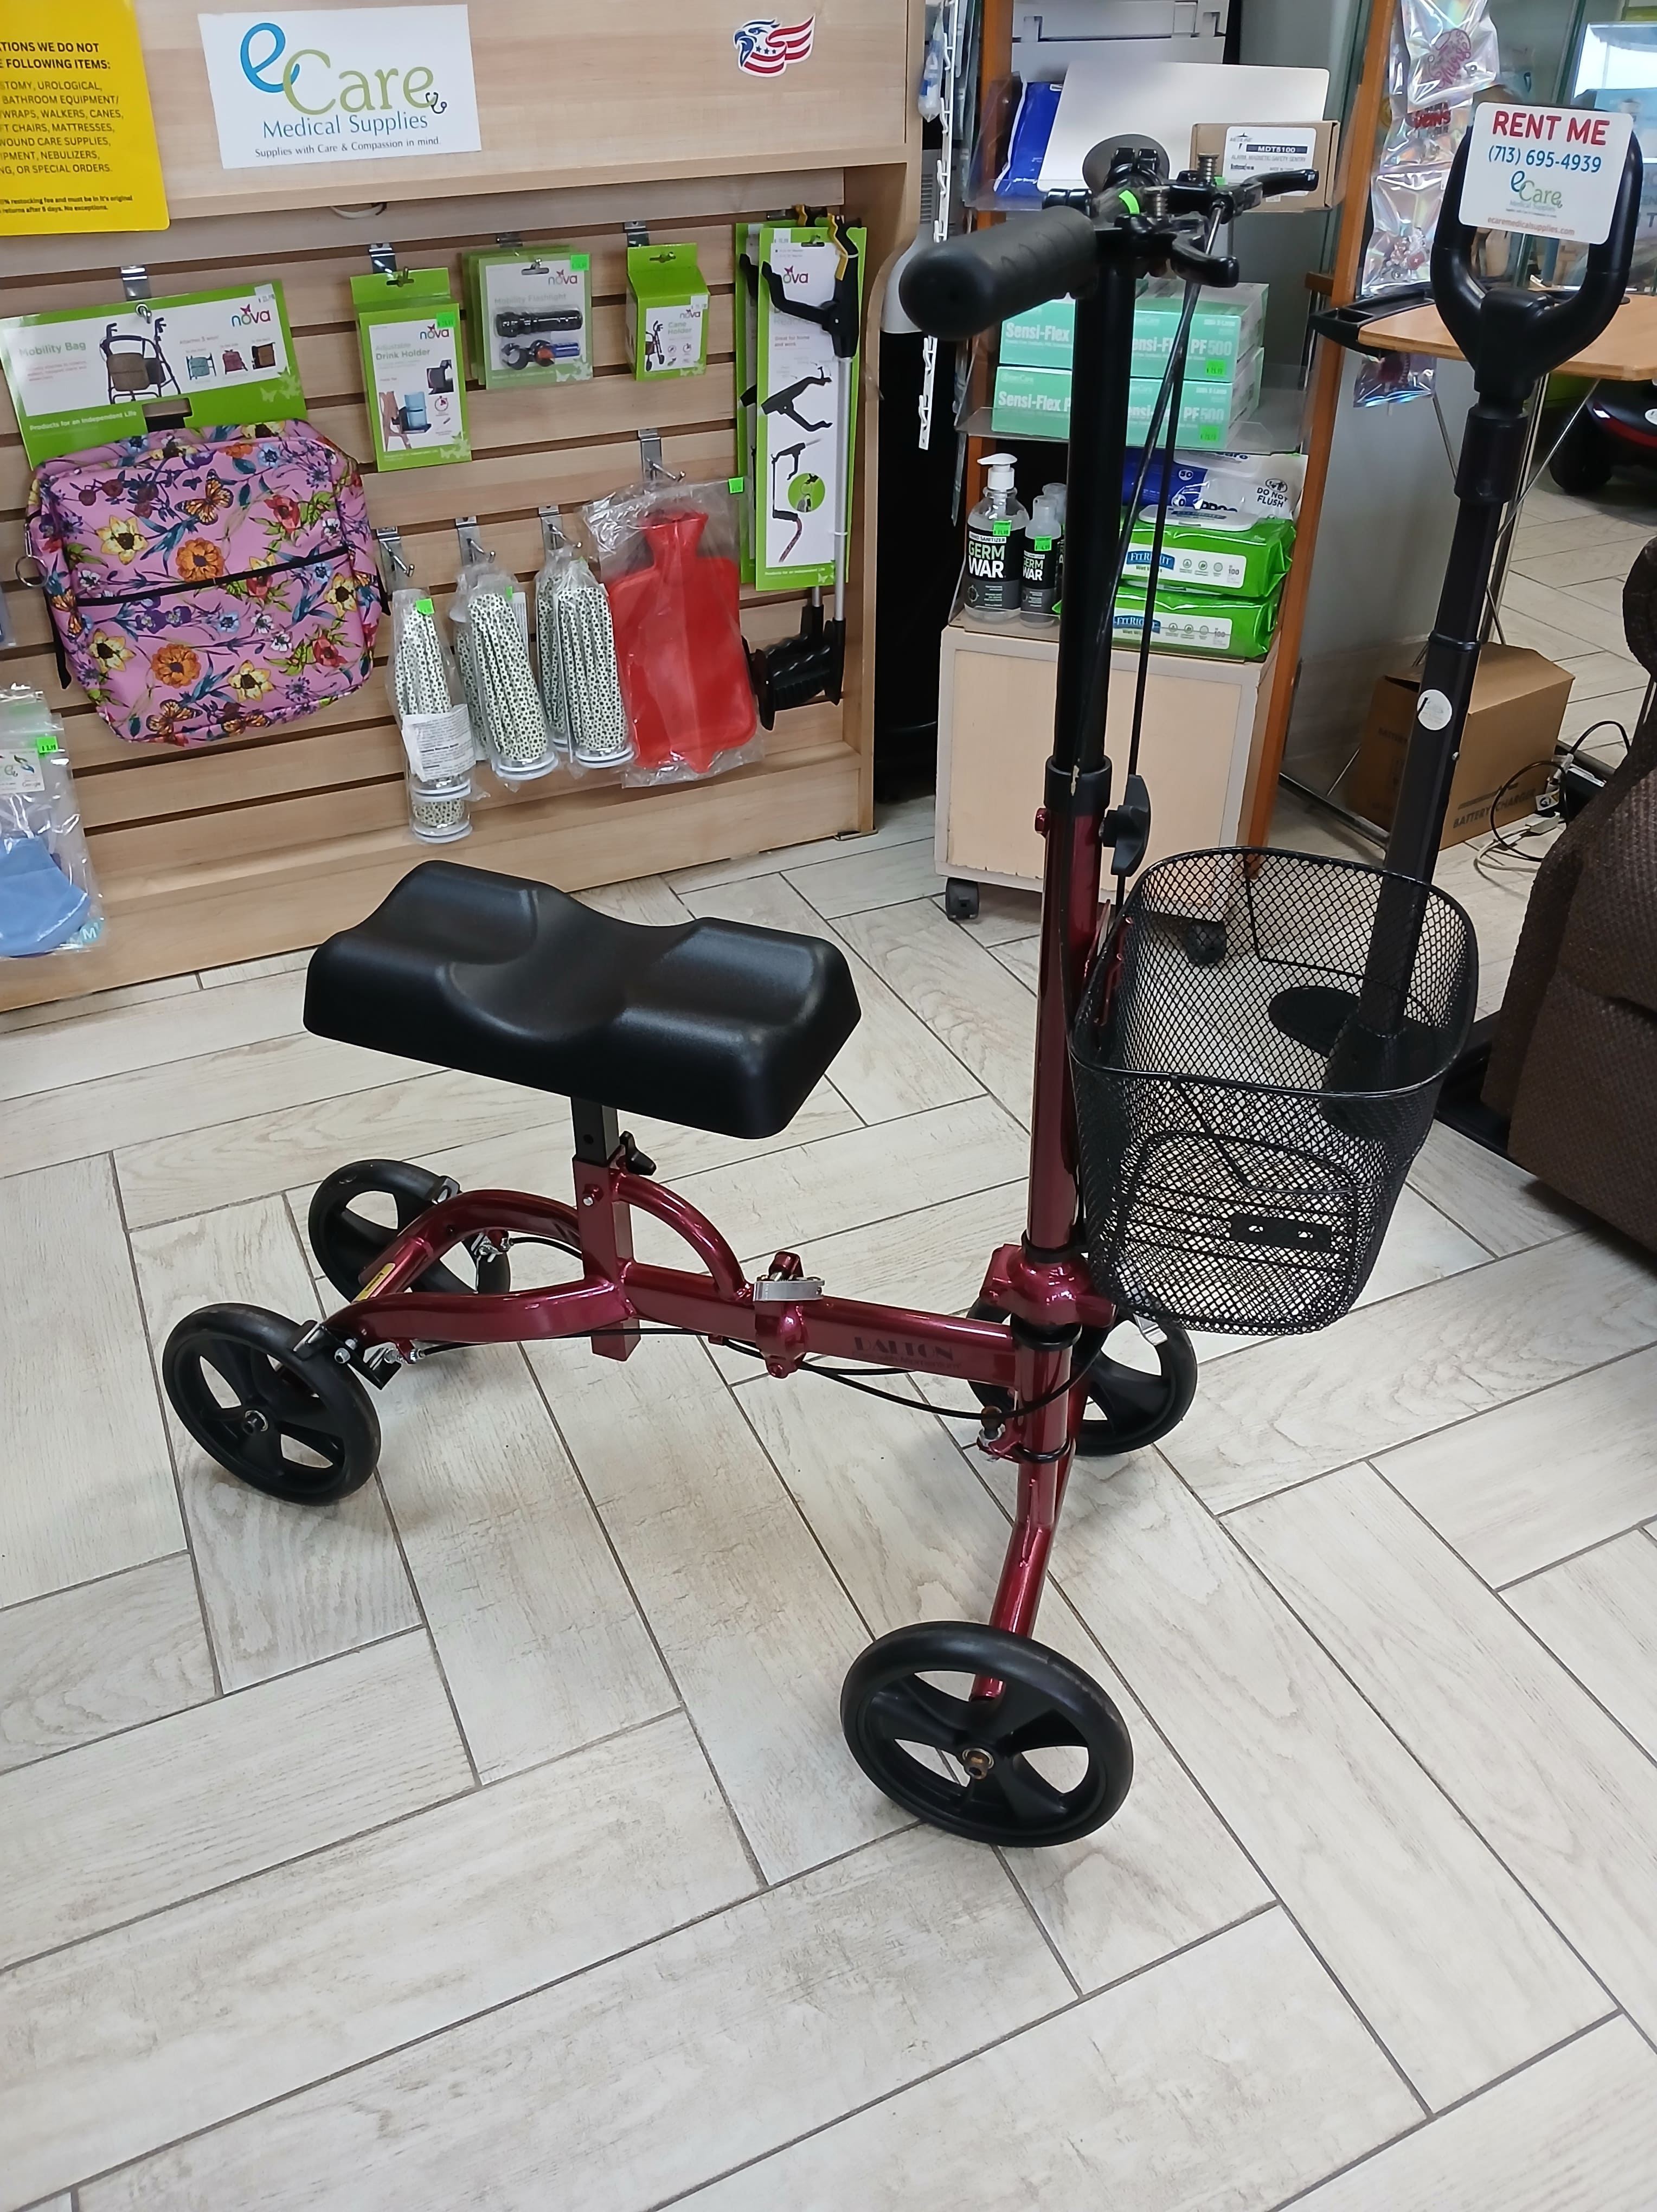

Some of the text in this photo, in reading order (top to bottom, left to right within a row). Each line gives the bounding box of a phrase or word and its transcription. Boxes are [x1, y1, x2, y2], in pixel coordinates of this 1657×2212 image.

[37, 42, 55, 52] WE
[57, 42, 74, 52] DO
[77, 43, 99, 53] NOT
[6, 59, 72, 69] FOLLOWING
[75, 60, 111, 69] ITEMS:
[240, 22, 434, 115] eCare
[38, 81, 102, 91] UROLOGICAL,
[3, 95, 119, 106] BATHROOM EQUIPMENT/
[41, 110, 88, 119] WALKERS,
[89, 109, 124, 119] CANES,
[12, 124, 50, 133] CHAIRS,
[52, 123, 115, 133] MATTRESSES,
[263, 111, 428, 139] Medical Supplies
[1492, 111, 1610, 145] RENT ME
[37, 137, 62, 146] CARE
[64, 137, 111, 146] SUPPLIES,
[255, 148, 292, 158] Supplies
[296, 145, 315, 155] with
[318, 144, 338, 153] Care
[341, 144, 348, 152] &
[351, 139, 403, 152] Compassion
[406, 138, 415, 148] in
[41, 150, 100, 160] NEBULIZERS,
[1488, 145, 1602, 173] (713) 695-4939
[16, 165, 30, 174] OR
[33, 164, 70, 173] SPECIAL
[73, 164, 112, 172] ORDERS.
[1511, 170, 1562, 206] eCare
[549, 275, 577, 285] nova
[782, 273, 808, 284] ova
[232, 310, 271, 327] nova
[420, 329, 449, 339] nova
[1006, 321, 1070, 342] Sensi-Flex
[65, 342, 87, 351] Bag
[376, 349, 431, 361] Drink Holder
[998, 391, 1061, 411] Sensi-Flex
[1257, 487, 1288, 502] DO NOT
[1257, 495, 1284, 508] FLUSH
[968, 541, 1005, 560] GERM
[968, 555, 1005, 578] WAR
[1023, 566, 1043, 581] WAR
[1453, 806, 1491, 829] BATTERY
